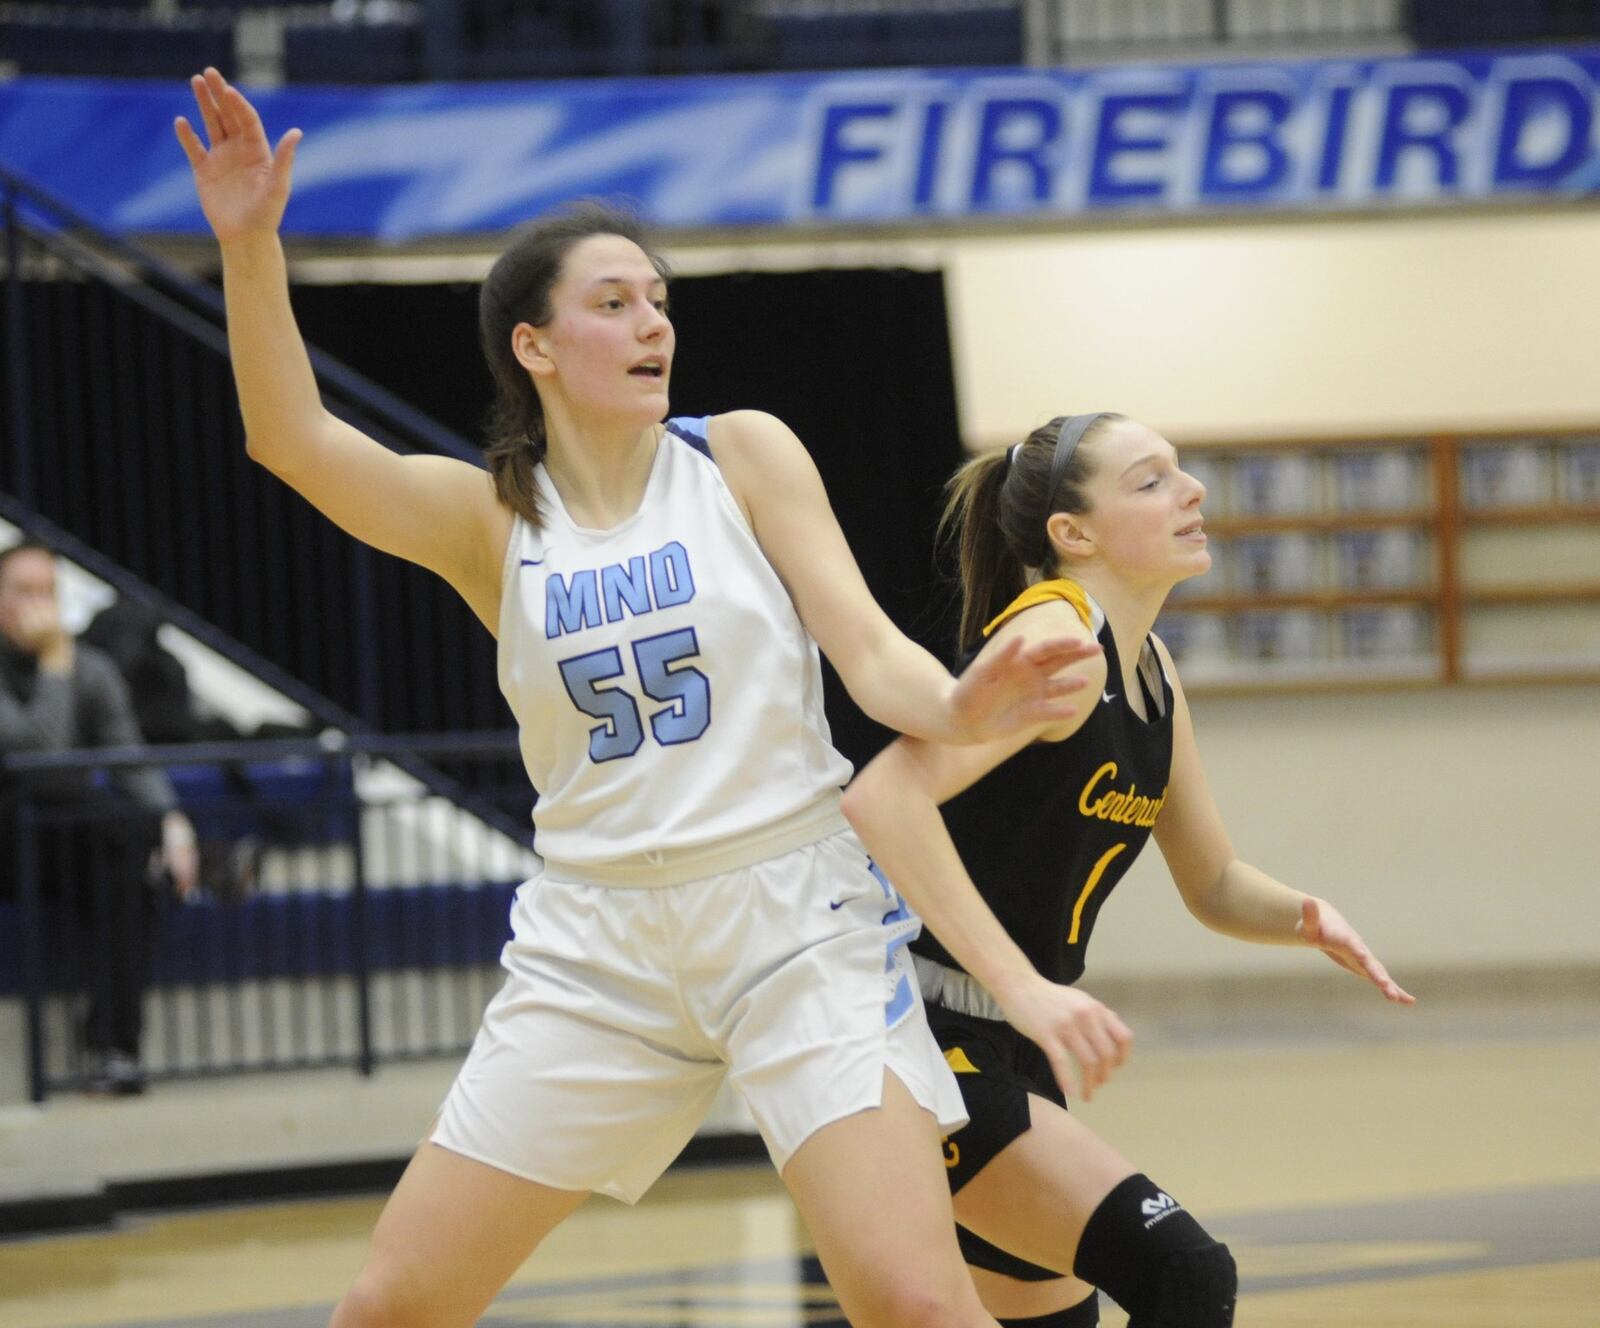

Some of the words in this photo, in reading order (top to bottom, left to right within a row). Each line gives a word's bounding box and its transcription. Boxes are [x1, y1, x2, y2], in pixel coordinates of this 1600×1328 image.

[810, 66, 1598, 211] FIREBIRD
[545, 541, 696, 640] MND
[557, 626, 711, 764] 55
[1067, 843, 1127, 945] 1
